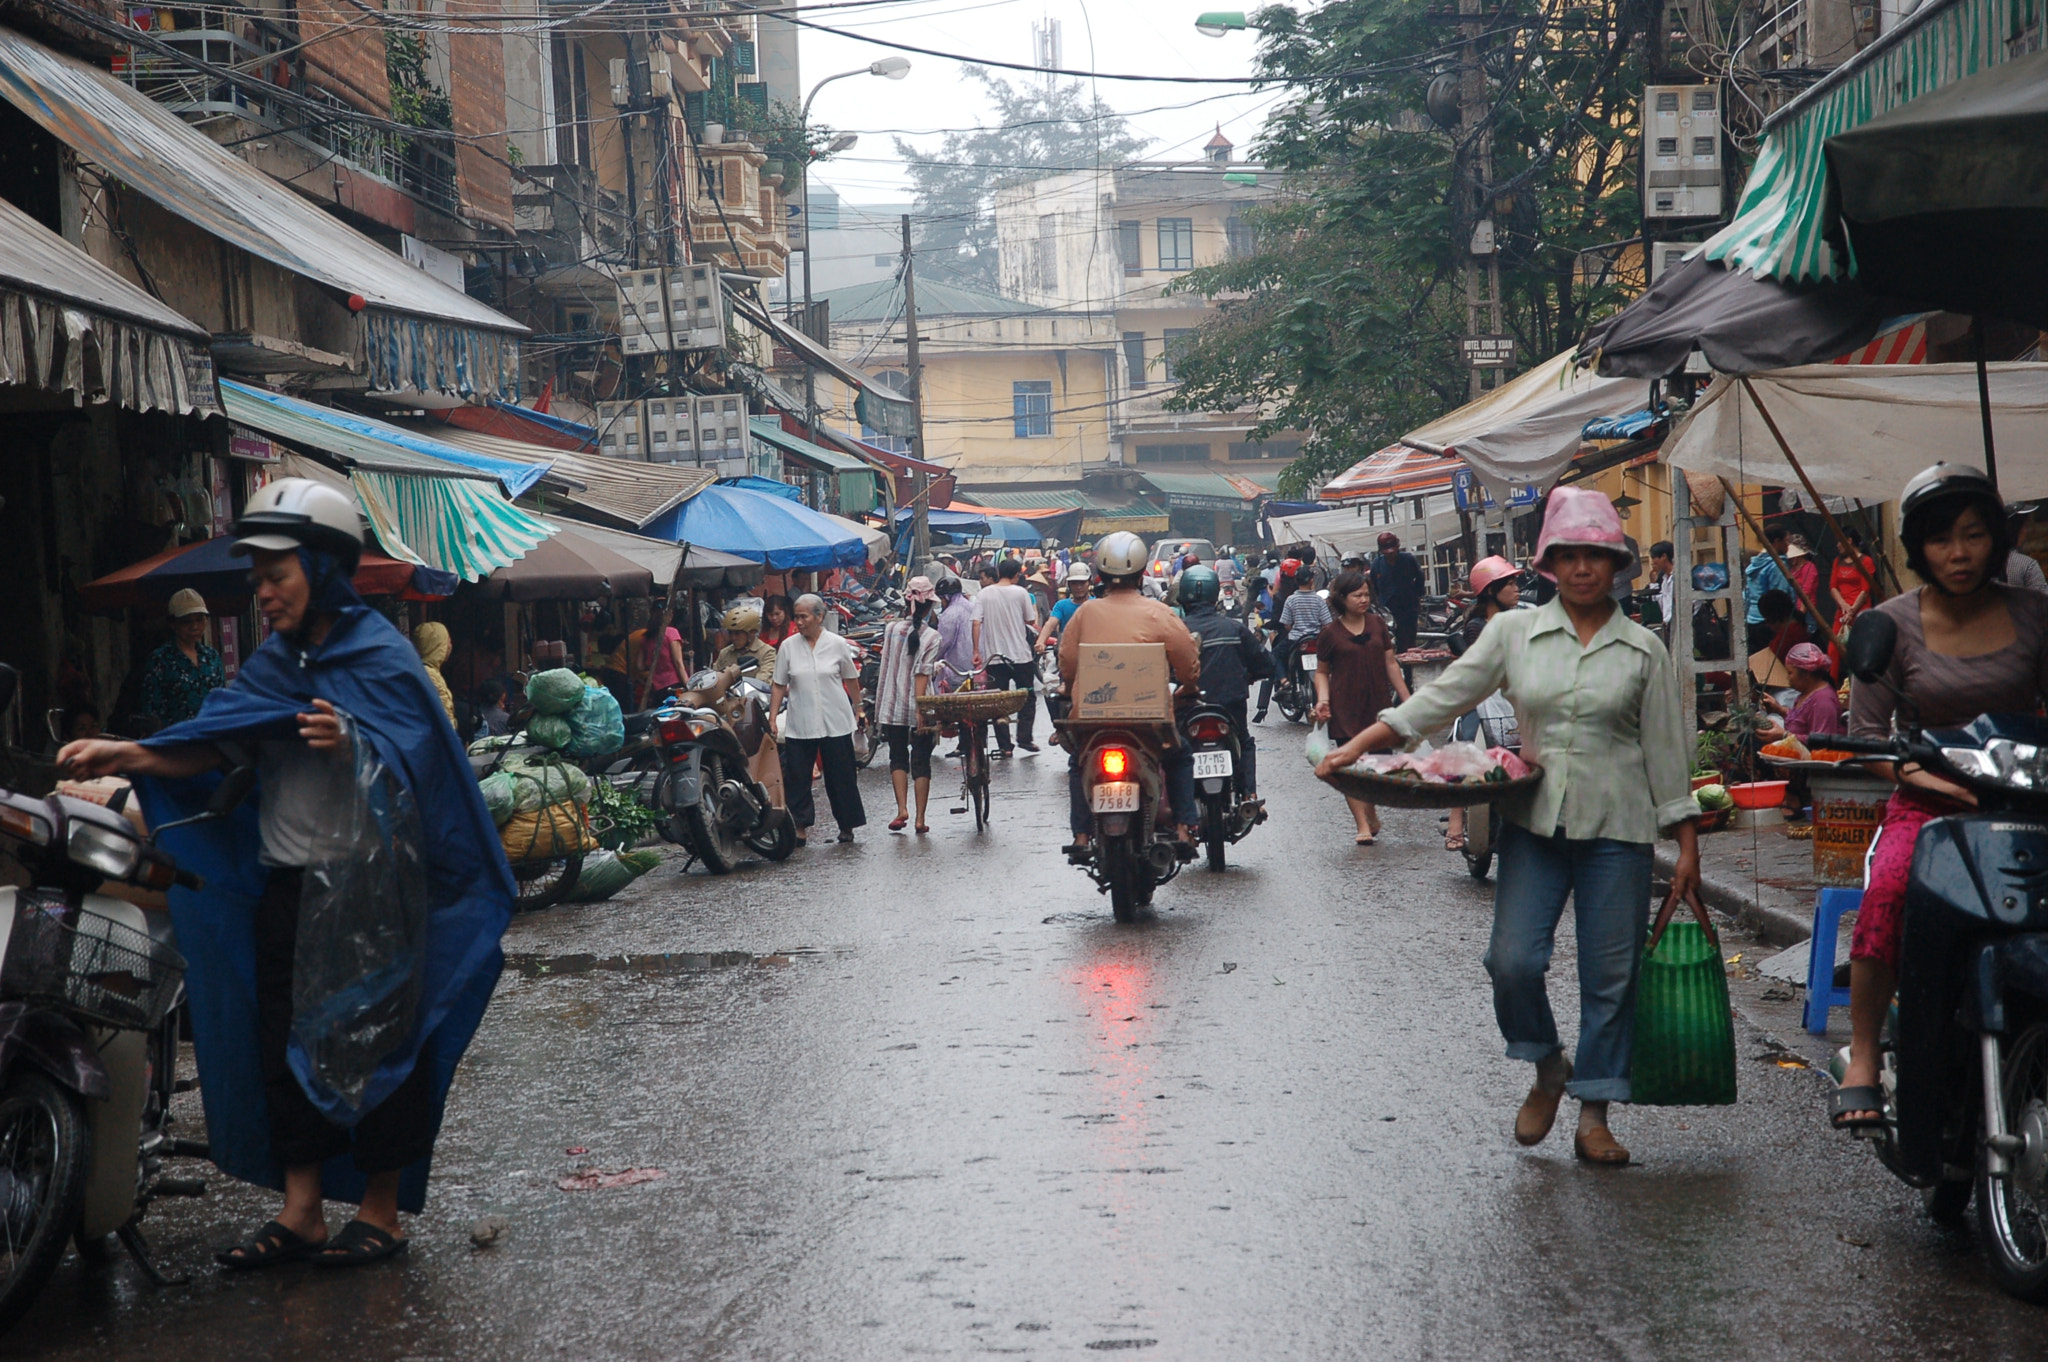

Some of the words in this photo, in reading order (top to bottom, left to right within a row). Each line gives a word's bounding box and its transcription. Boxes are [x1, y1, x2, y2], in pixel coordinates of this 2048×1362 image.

[1464, 340, 1480, 350] HOTEL
[1498, 339, 1513, 349] XUAN
[1198, 764, 1226, 775] 5012
[1099, 798, 1132, 809] 7584
[1828, 806, 1875, 820] JOTUN
[1991, 821, 2048, 833] HONDA
